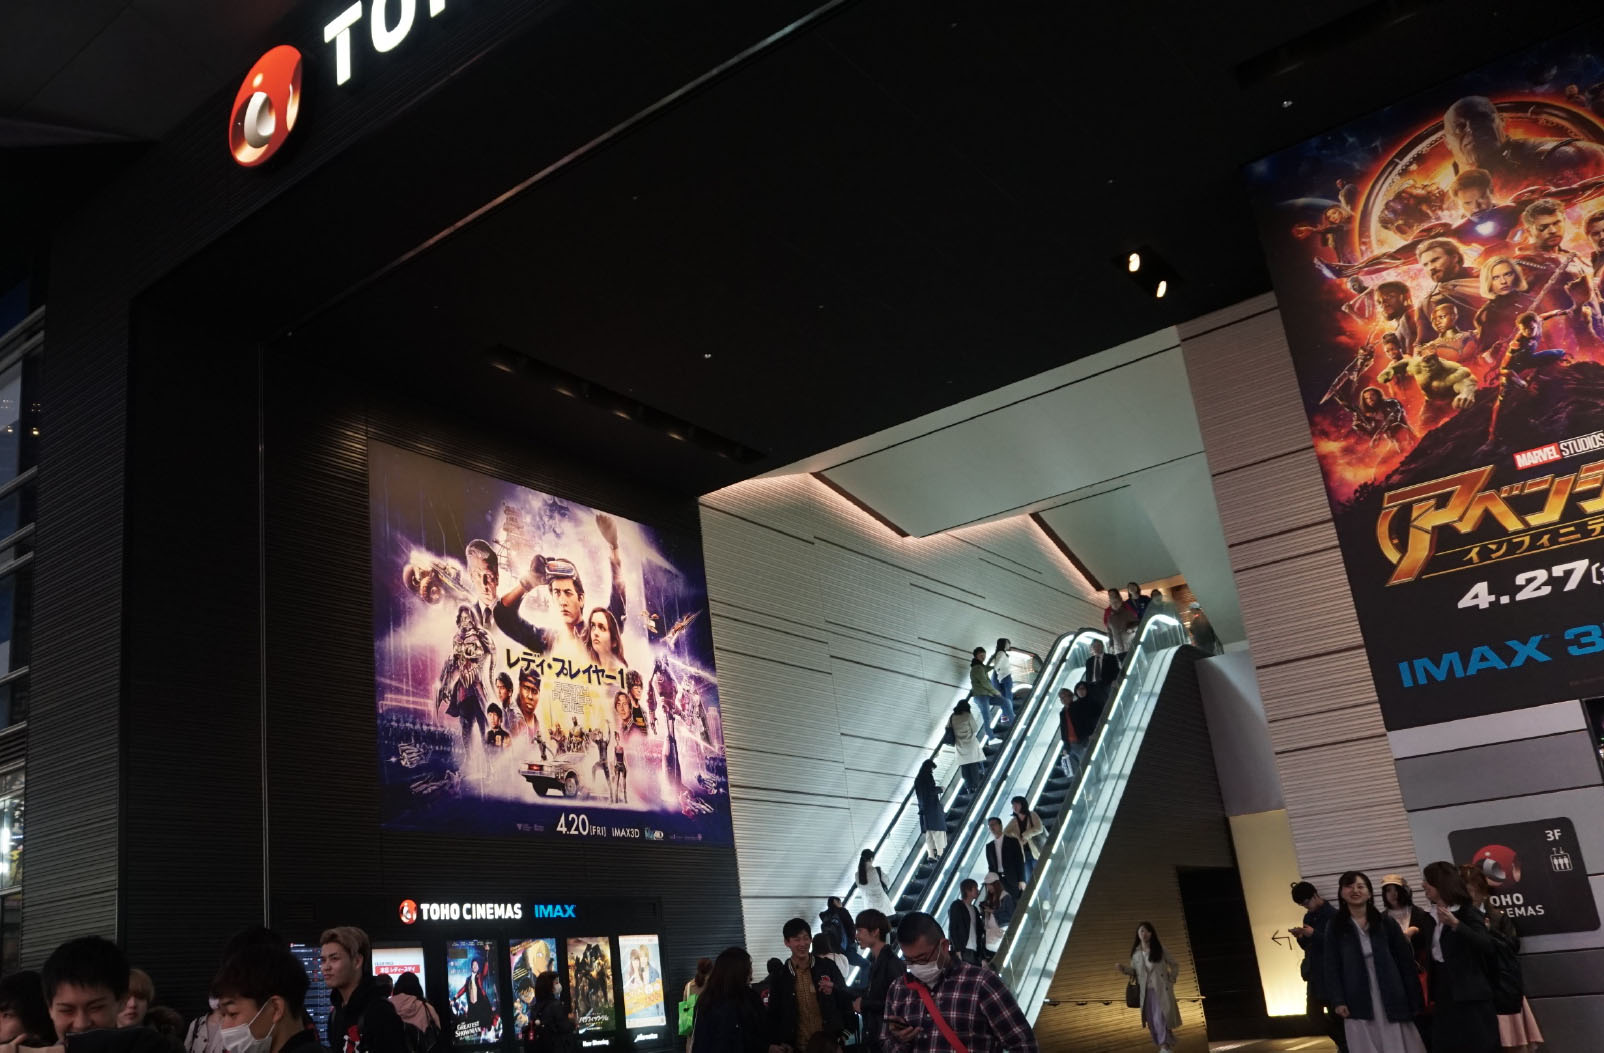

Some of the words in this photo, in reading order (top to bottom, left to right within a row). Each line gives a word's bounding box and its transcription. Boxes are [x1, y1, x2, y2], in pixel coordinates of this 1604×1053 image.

[323, 0, 446, 86] TO
[1515, 445, 1561, 468] MARVEL
[1559, 432, 1604, 456] STUDIOS
[1397, 634, 1552, 688] IMAX
[1563, 622, 1604, 656] 3
[505, 648, 626, 690] レディ・プレイヤー1
[556, 812, 589, 836] 4.20
[611, 827, 640, 839] IMAX3D
[1544, 829, 1562, 841] 3F
[1489, 892, 1524, 907] OHO
[420, 903, 460, 920] TOHO
[462, 903, 522, 920] CINEMAS
[534, 904, 576, 918] IMAX
[1505, 904, 1545, 918] EMAS
